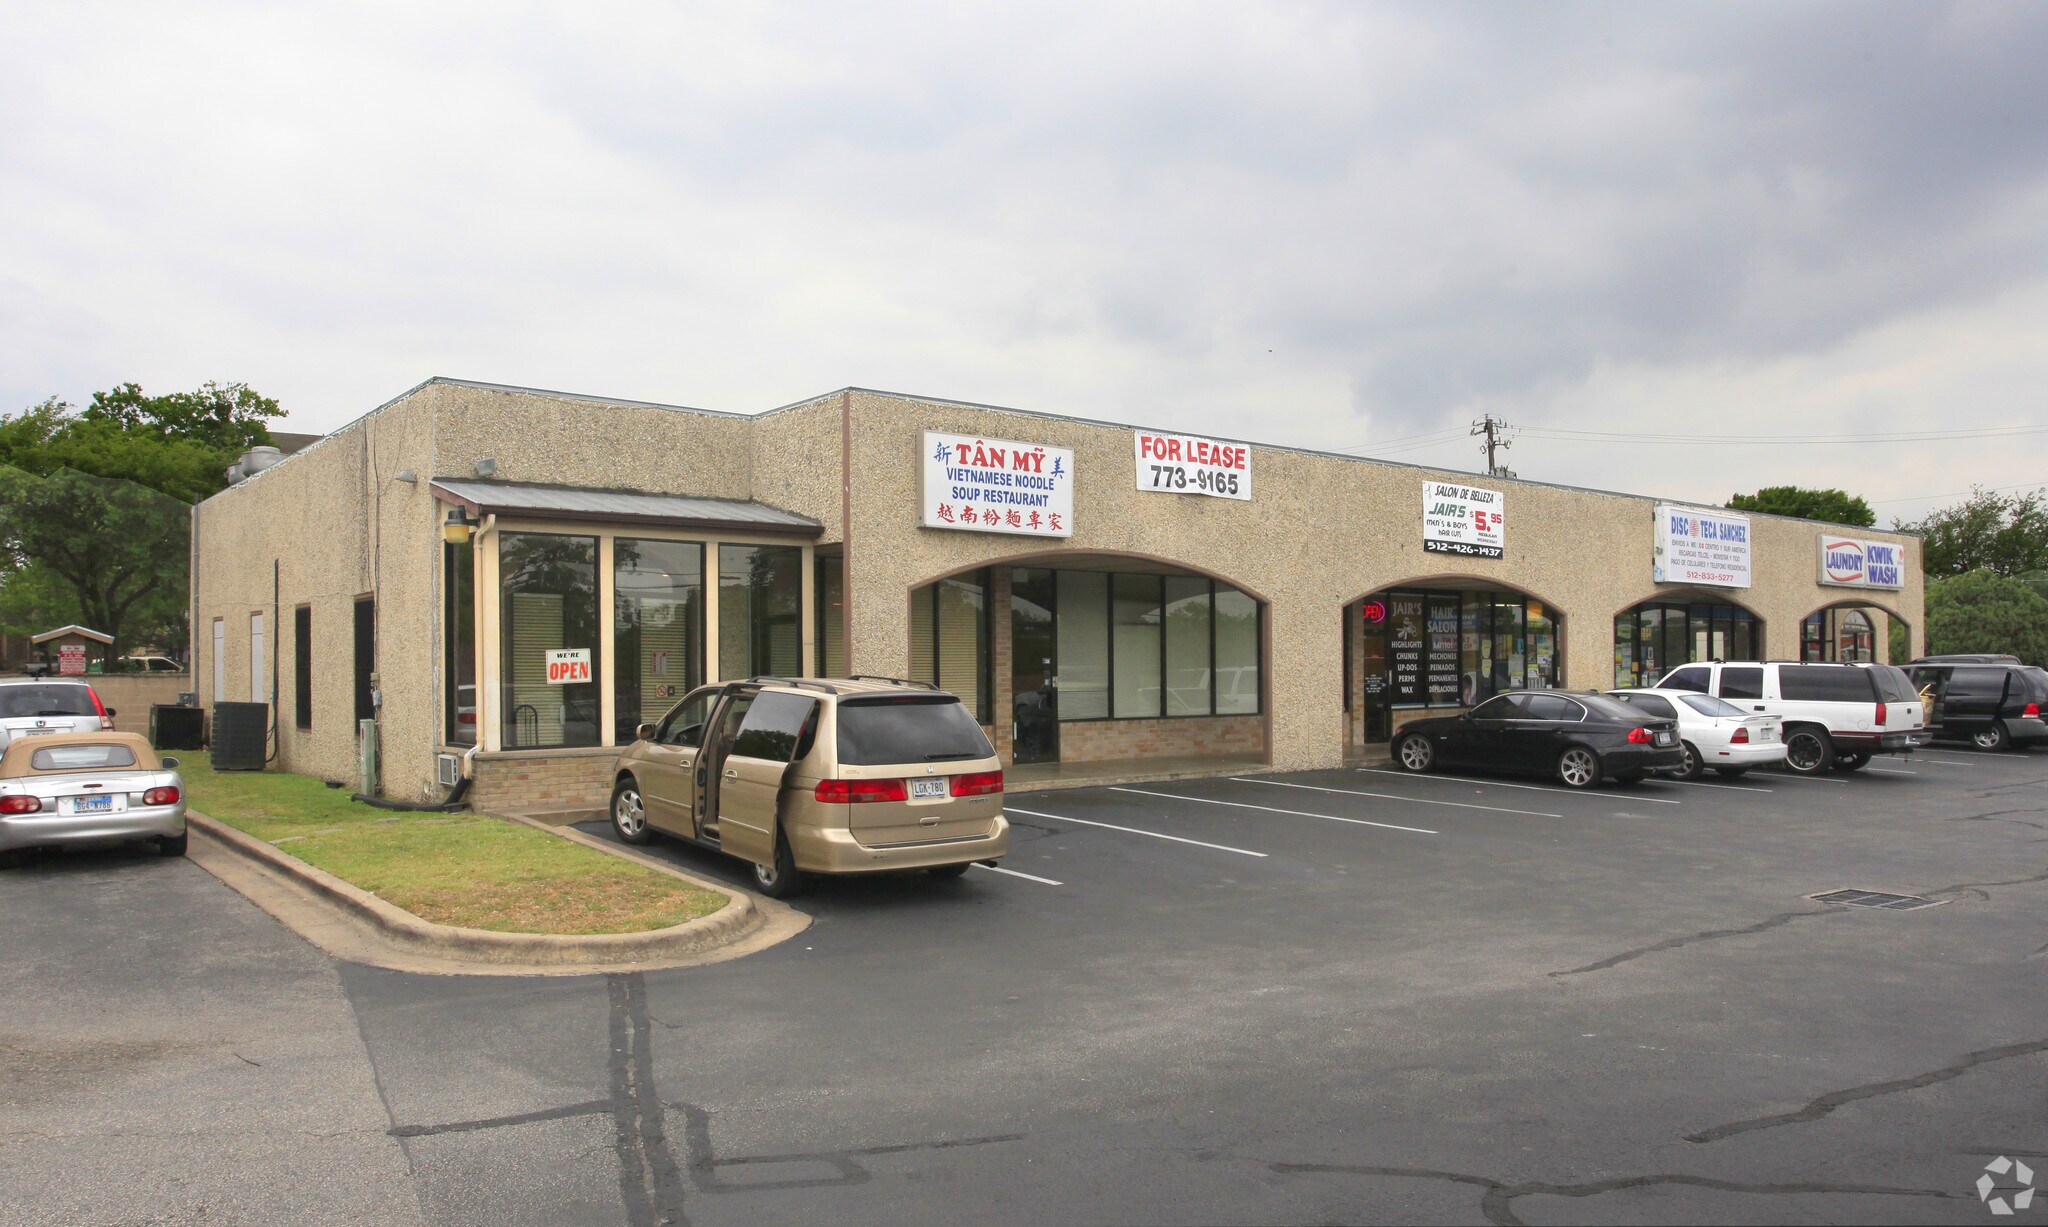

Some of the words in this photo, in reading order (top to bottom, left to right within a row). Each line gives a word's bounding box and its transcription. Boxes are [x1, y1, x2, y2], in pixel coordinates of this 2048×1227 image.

[933, 441, 952, 466] 新
[956, 440, 1006, 469] TÂN
[1012, 447, 1046, 473] MỸ
[1141, 436, 1181, 461] FOR
[1187, 441, 1245, 470] LEASE
[1051, 456, 1065, 479] 美
[946, 467, 1012, 486] VIETNAMESE
[1015, 474, 1054, 490] NOODLE
[1151, 465, 1238, 495] 773-9165
[952, 486, 980, 501] SOUP
[983, 489, 1049, 507] RESTAURANT
[1435, 485, 1459, 498] SALON
[1460, 488, 1469, 500] DE
[1470, 490, 1494, 504] BELLEZA
[1429, 502, 1466, 518] JAIR'S
[1453, 521, 1468, 530] BOYS
[1719, 523, 1746, 543] SANCHEZ
[1427, 541, 1501, 557] 512-426-1437
[1705, 543, 1719, 551] CENTRO
[1732, 546, 1747, 554] AMERICA
[1867, 545, 1894, 565] KWIK
[1826, 551, 1864, 571] LAUNDRY
[1686, 570, 1734, 581] 512-833-5277
[1868, 565, 1898, 585] WASH
[1392, 601, 1422, 617] JAIR'S
[1430, 606, 1454, 619] HAIR
[1427, 620, 1457, 633] SALON
[1391, 641, 1423, 649] HIGHLIGHTS
[1396, 652, 1418, 660] CHUNKS
[1429, 652, 1457, 660] MECHONES
[550, 661, 589, 680] OPEN
[1398, 675, 1416, 683] PERMS
[1401, 686, 1414, 694] WAX
